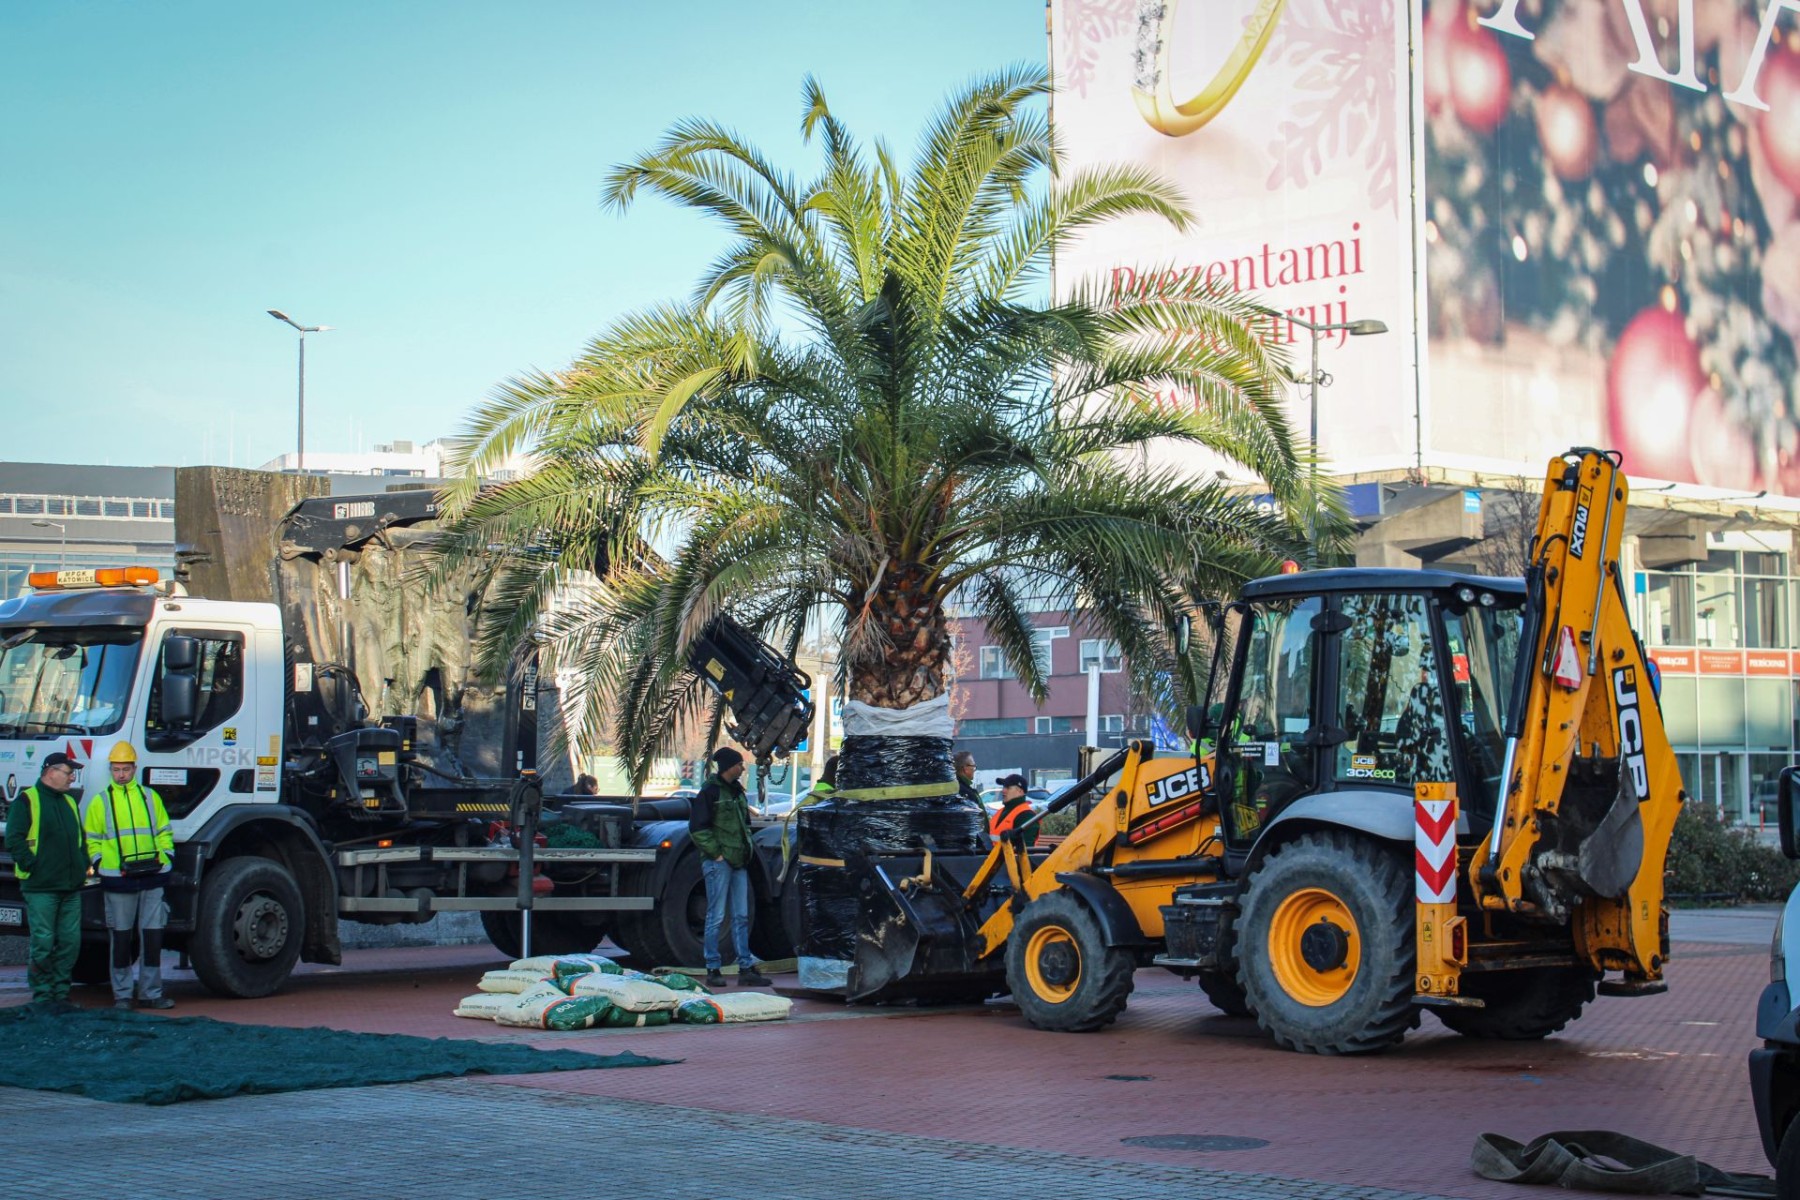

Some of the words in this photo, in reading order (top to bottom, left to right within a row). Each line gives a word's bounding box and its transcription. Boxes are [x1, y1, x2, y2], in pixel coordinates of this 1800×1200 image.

[349, 501, 375, 518] HIAB
[1570, 505, 1588, 554] 3CX
[187, 747, 252, 766] MPGK
[1354, 757, 1375, 765] JCB
[1346, 768, 1396, 779] 3CXeco
[1149, 766, 1210, 805] JCB
